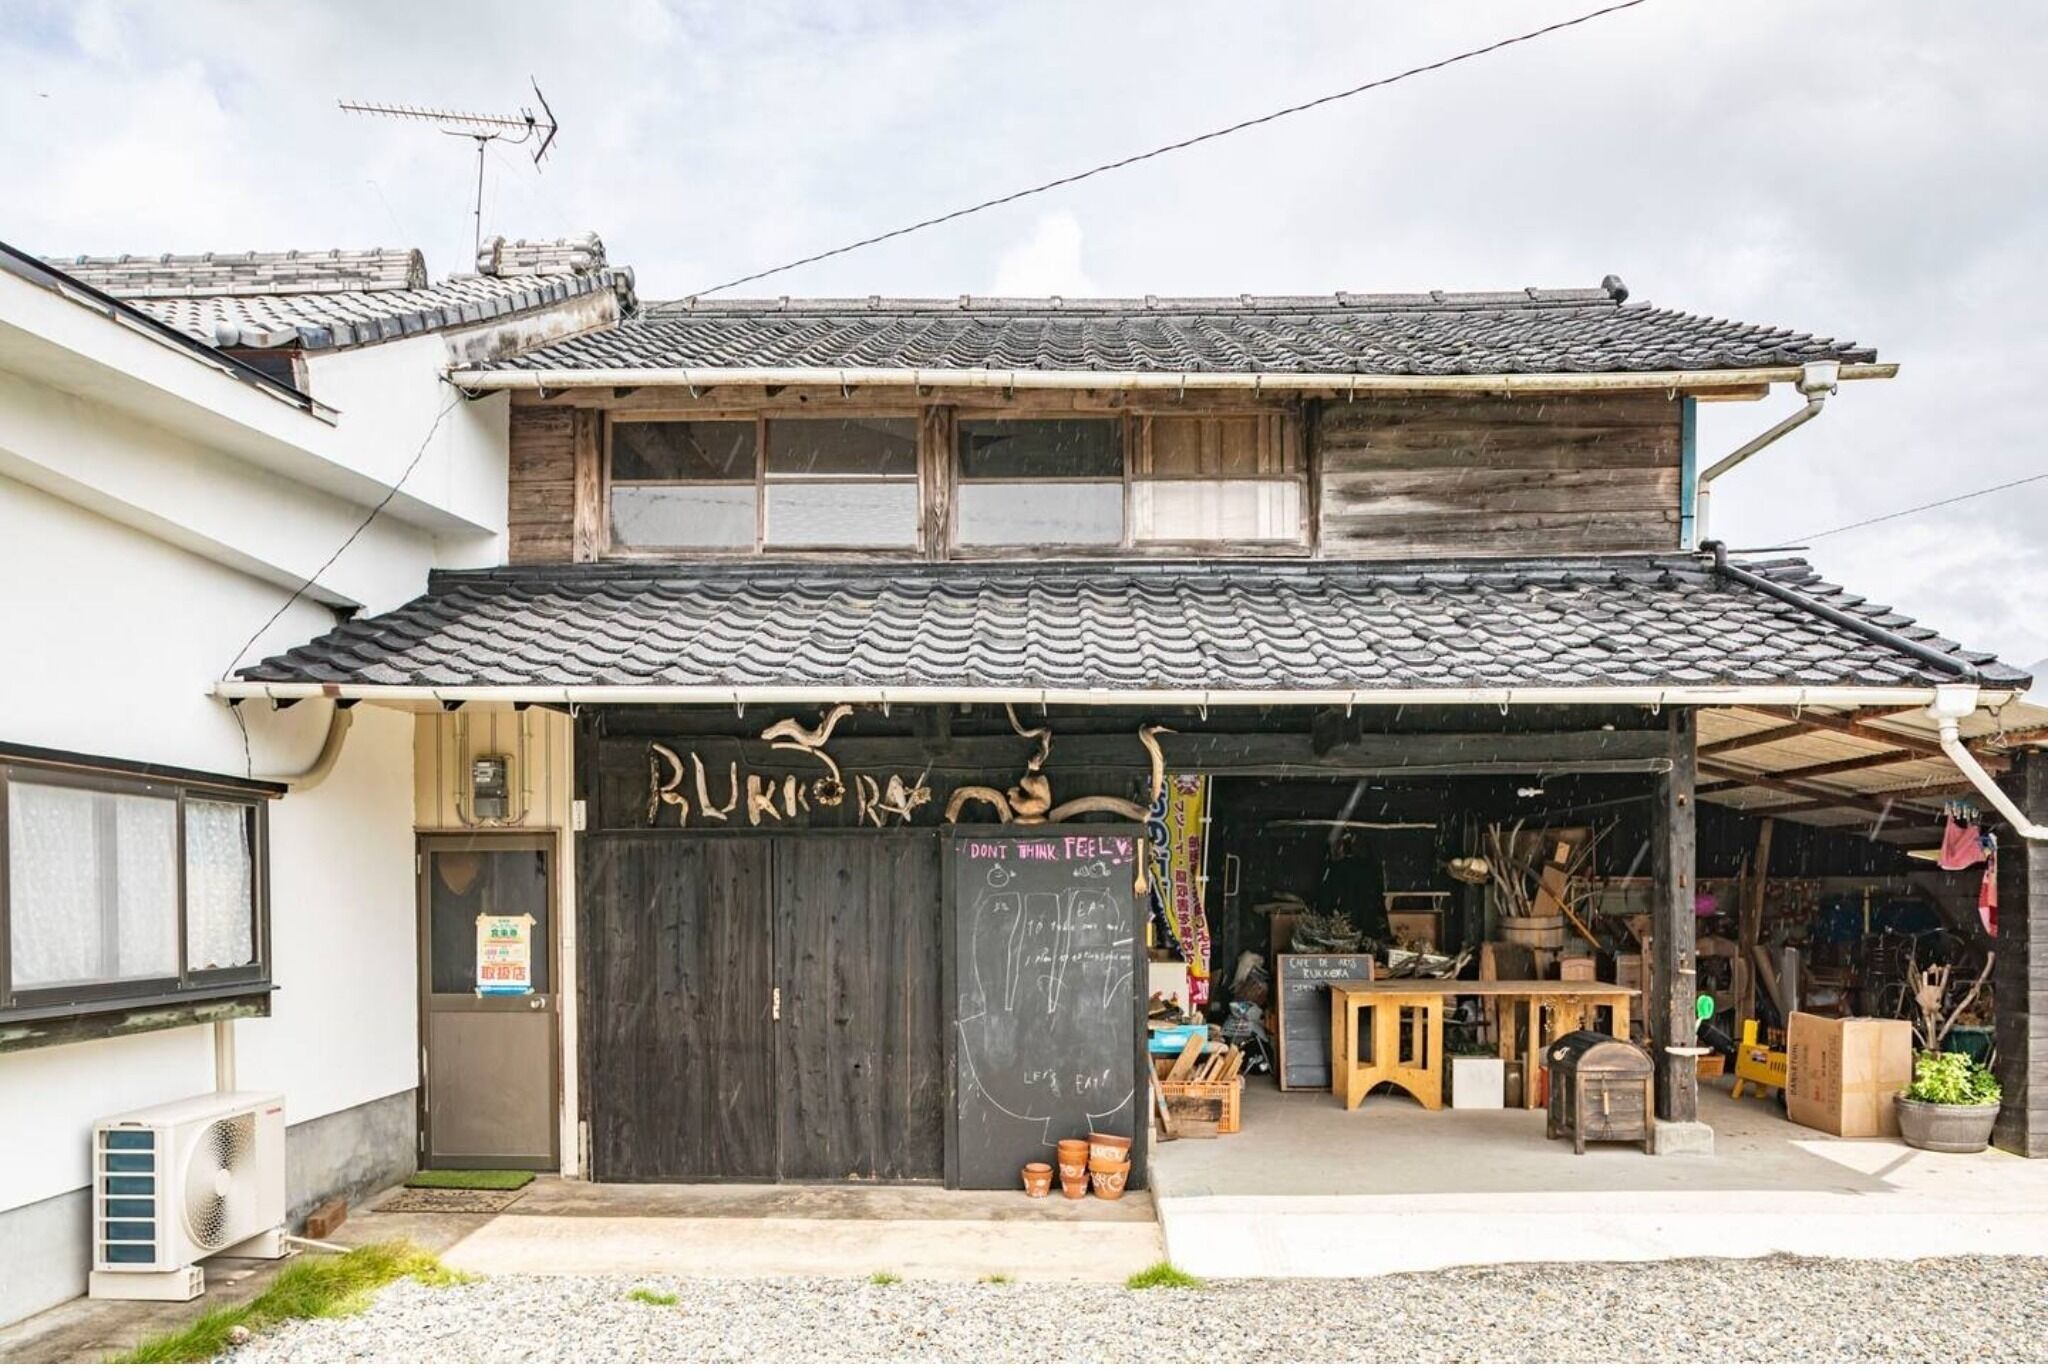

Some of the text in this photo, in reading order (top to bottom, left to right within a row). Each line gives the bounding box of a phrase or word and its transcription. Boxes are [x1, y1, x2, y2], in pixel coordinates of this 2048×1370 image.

[1016, 845, 1058, 861] THINK
[1064, 837, 1112, 860] FEEL
[481, 965, 527, 981] 取扱店
